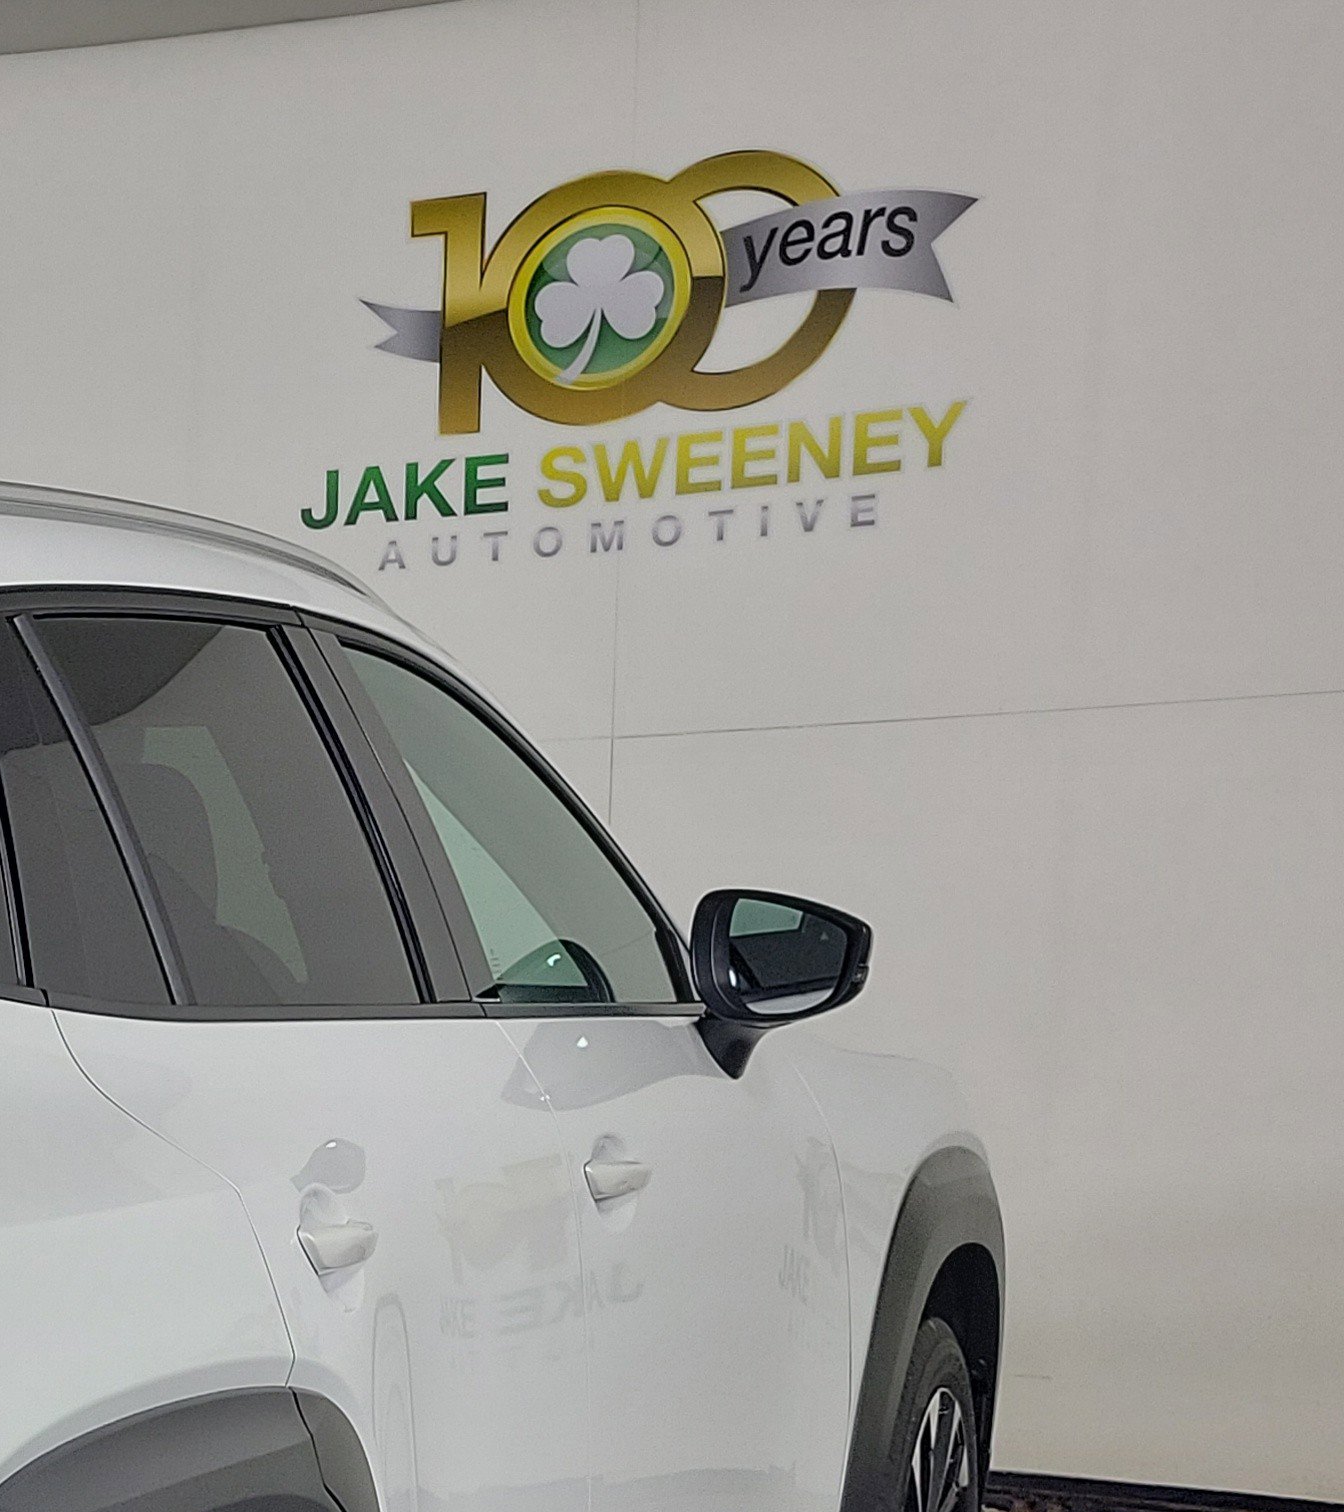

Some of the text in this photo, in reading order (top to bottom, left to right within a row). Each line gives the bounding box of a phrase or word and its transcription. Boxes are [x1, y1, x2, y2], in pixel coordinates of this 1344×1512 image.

[411, 150, 919, 434] 100 years
[300, 400, 969, 530] JAKE SWEENEY
[377, 494, 878, 572] AUTOMOTIVE
